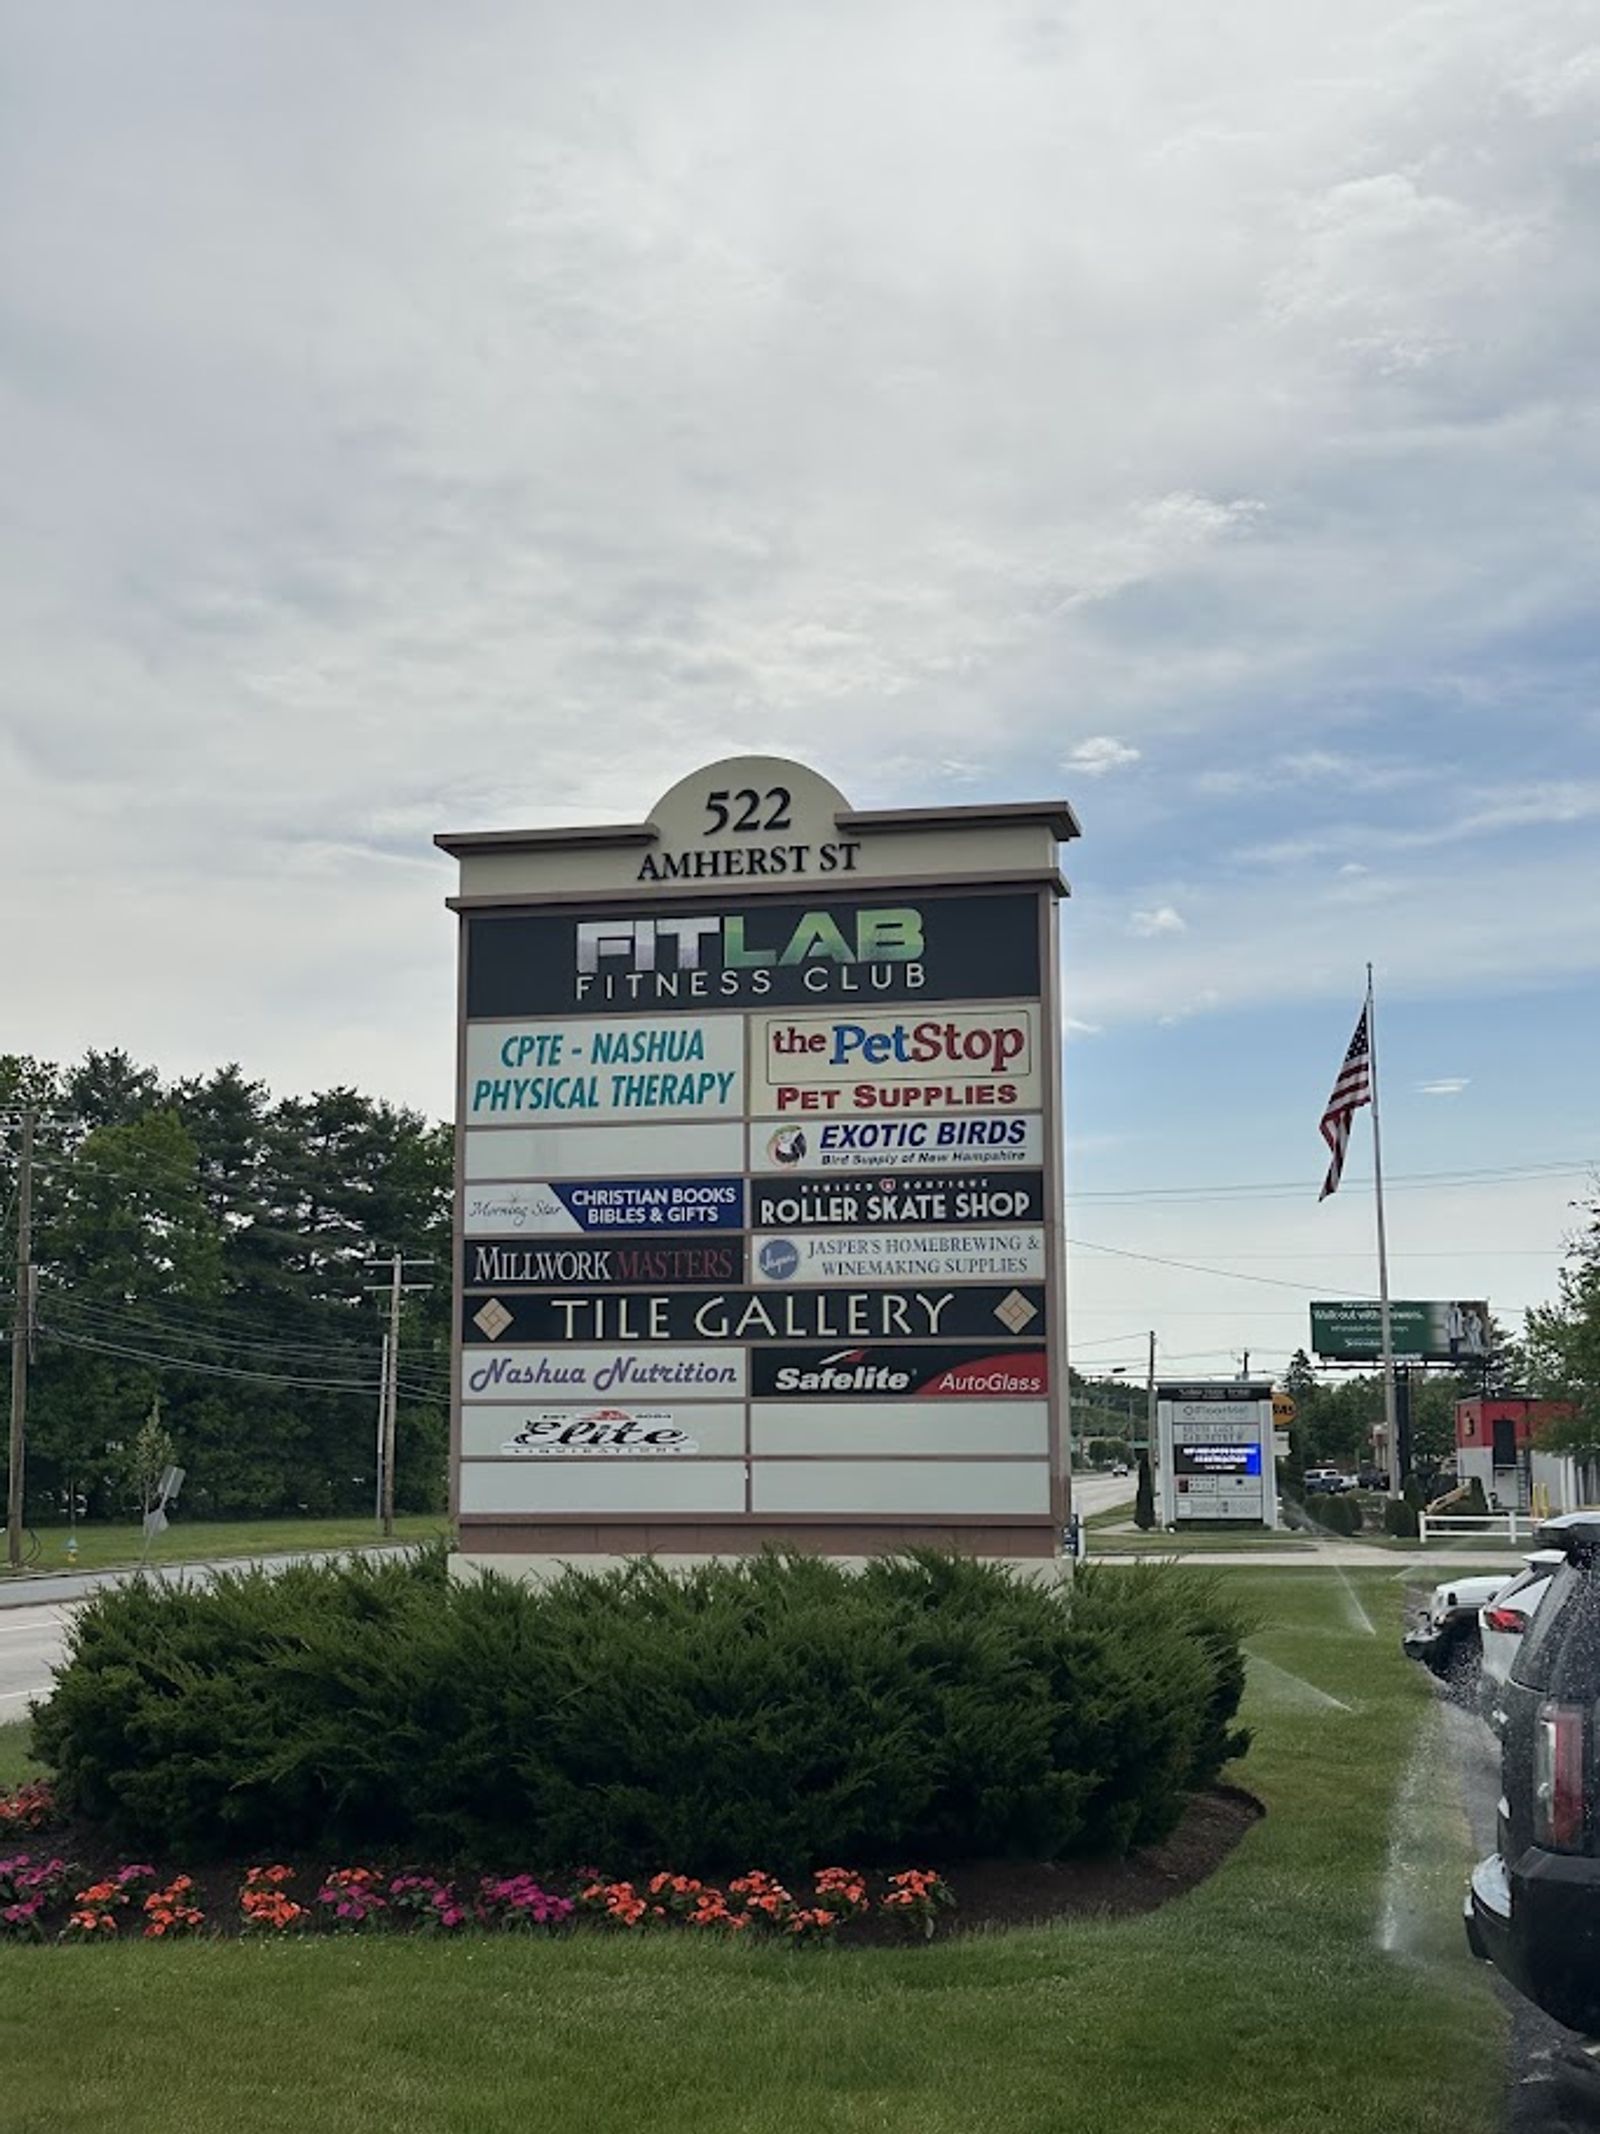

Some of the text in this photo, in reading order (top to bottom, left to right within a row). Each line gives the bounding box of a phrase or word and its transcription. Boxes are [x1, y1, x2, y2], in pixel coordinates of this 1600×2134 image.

[703, 787, 792, 835] 522
[637, 842, 861, 880] AMHERST ST
[576, 909, 925, 973] FITLAB
[576, 963, 925, 999] FITNESS CLUB
[501, 1035, 563, 1067] CPTE
[591, 1029, 704, 1064] NASHUA
[773, 1027, 826, 1053] the
[473, 1071, 735, 1111] PHYSICAL THERAPY
[777, 1084, 1017, 1110] PET SUPPLIES
[820, 1120, 1026, 1149] EXOTIC BIRDS
[822, 1150, 1025, 1166] Bird Supply of New Hampshire
[572, 1187, 736, 1206] CHRISTIAN BOOKS
[761, 1192, 1030, 1224] ROLLER SKATE SHOP
[469, 1198, 562, 1226] Morning Star
[588, 1206, 718, 1224] BIBLES & GIFTS
[808, 1236, 1040, 1258] JASPER'S HOMEBREWING &
[473, 1246, 733, 1281] MILLWORK MASTERS
[822, 1258, 1028, 1276] WINEMAKING SUPPLIES
[551, 1293, 954, 1339] TILE GALLERY
[469, 1356, 737, 1392] Nashua Nutrition
[775, 1366, 1040, 1391] Safelite AutoGlass
[513, 1419, 690, 1446] Elite
